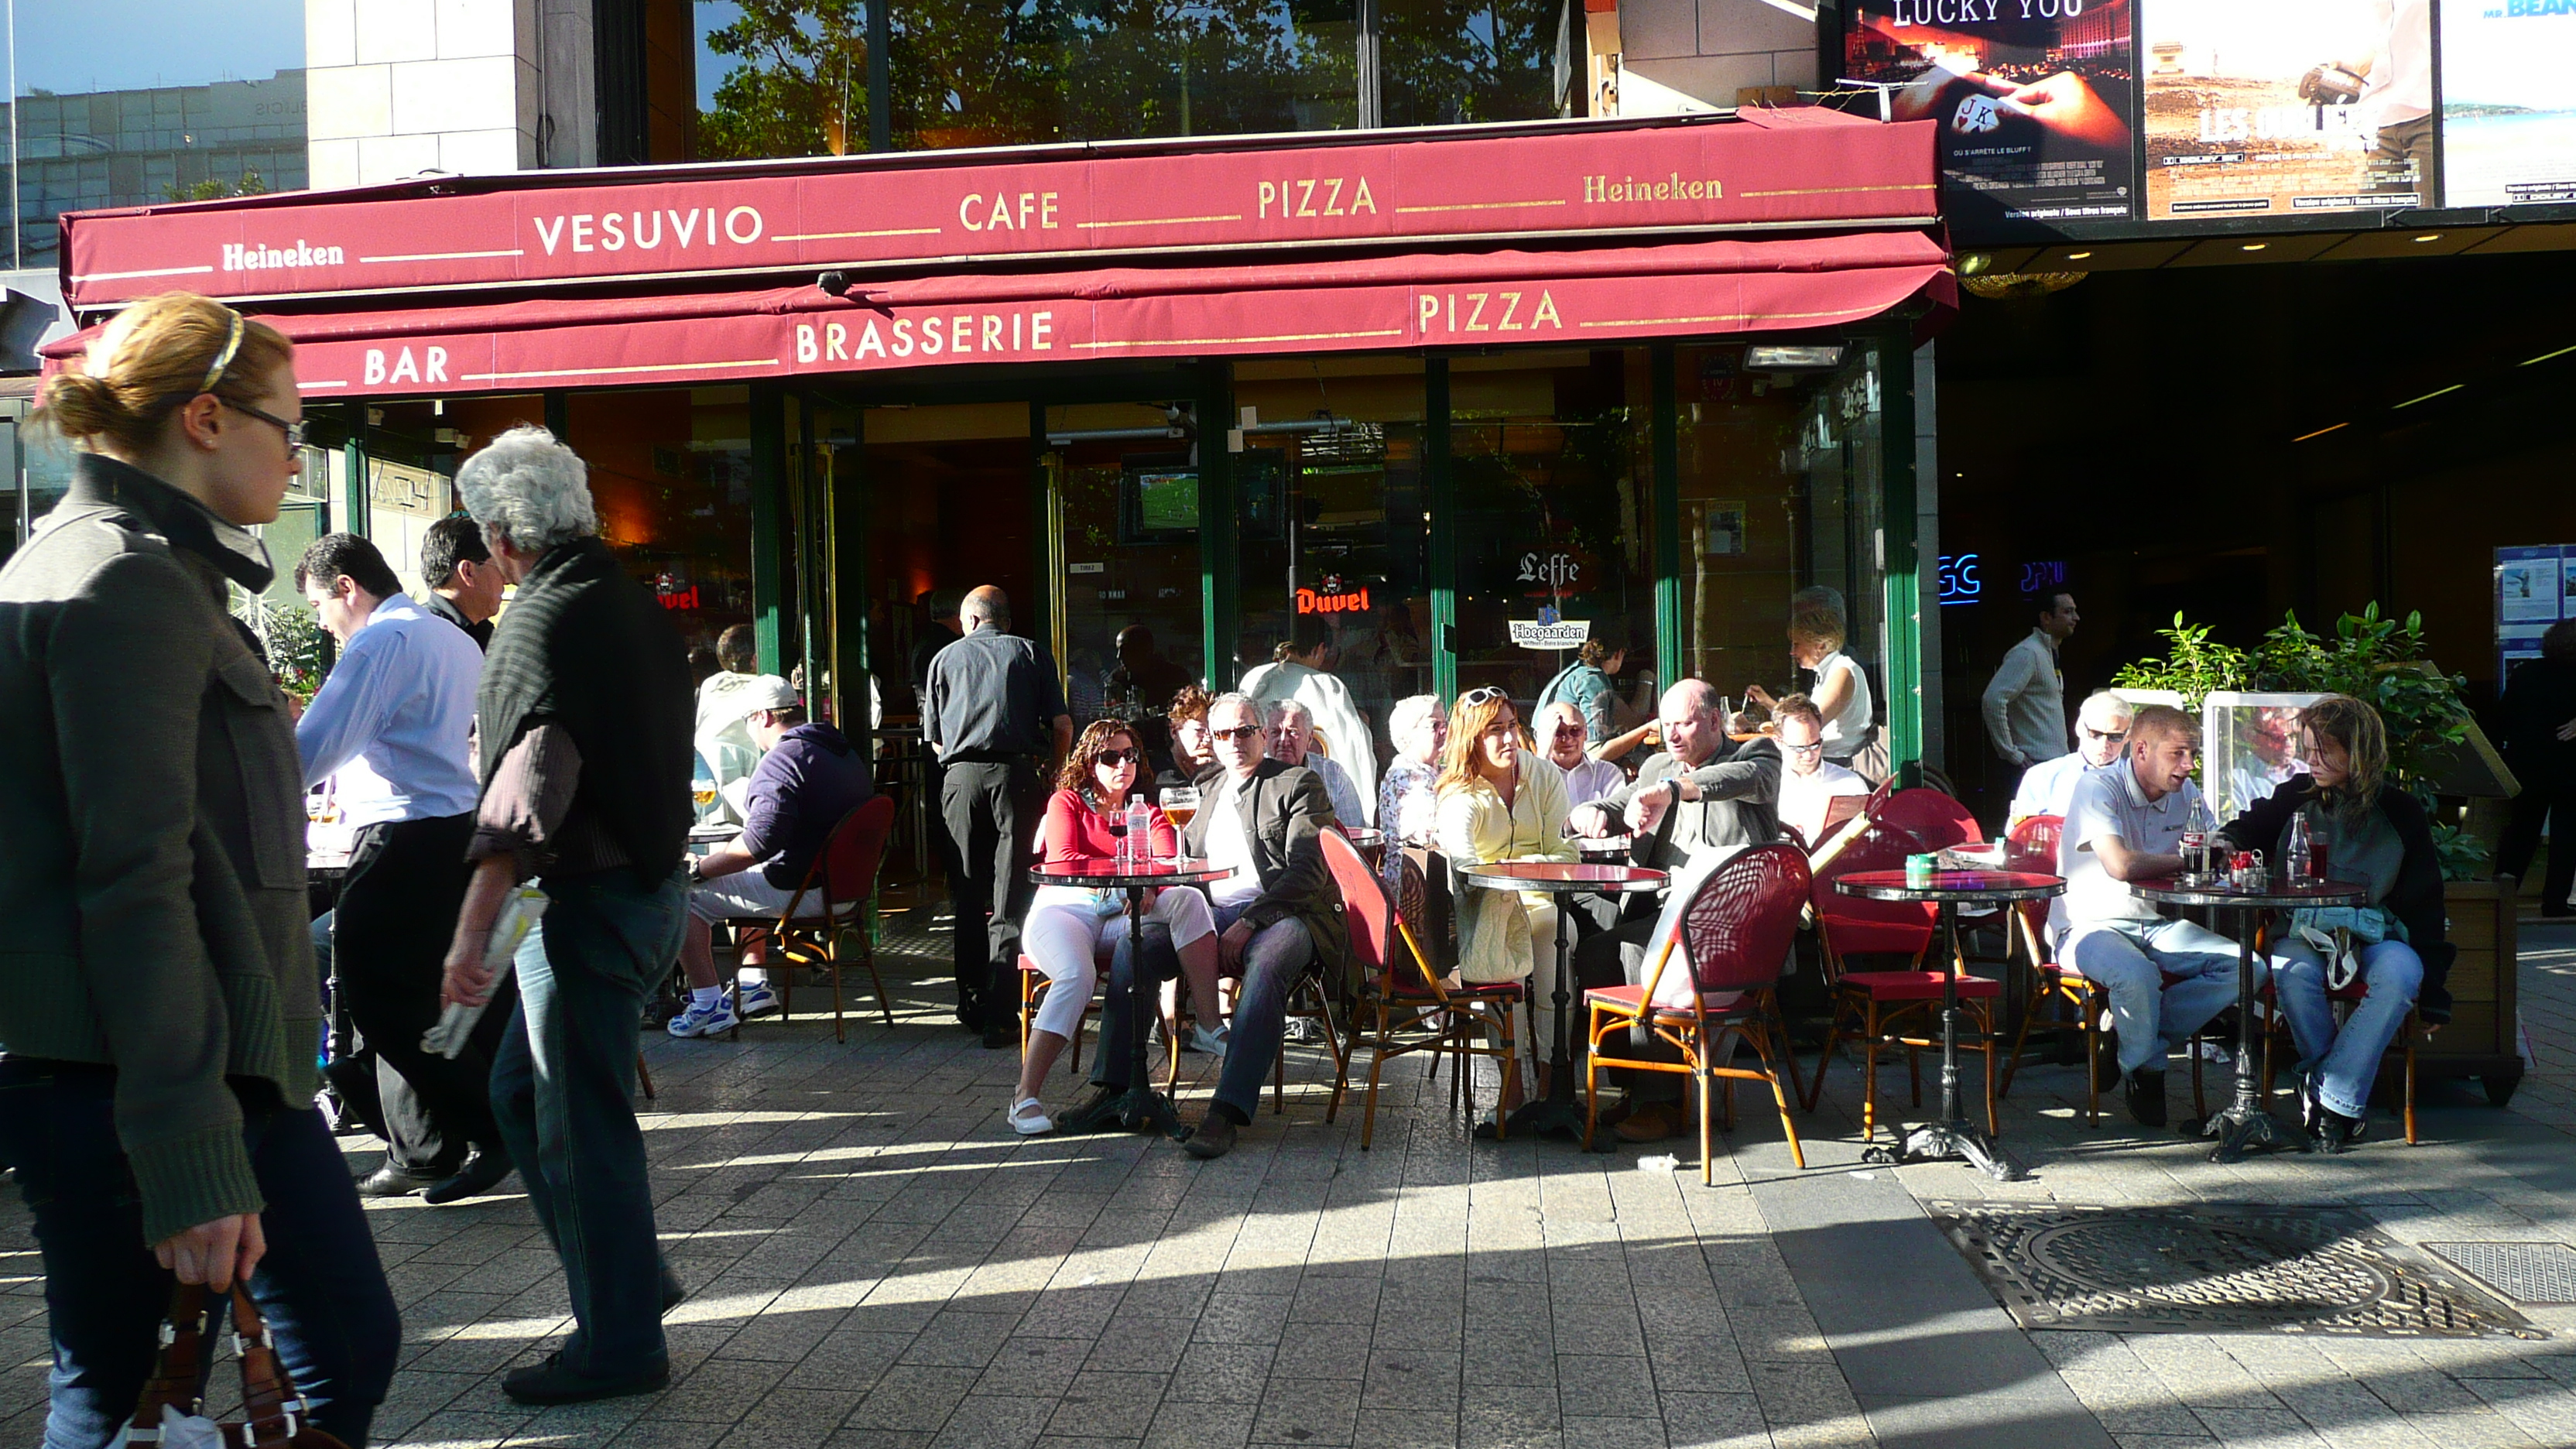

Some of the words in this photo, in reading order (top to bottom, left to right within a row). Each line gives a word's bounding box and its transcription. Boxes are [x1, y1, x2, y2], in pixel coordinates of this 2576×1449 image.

[1893, 0, 1998, 27] LUCKY
[2021, 0, 2082, 19] YOU
[1961, 99, 1976, 115] J
[1975, 106, 1992, 124] K
[2200, 107, 2249, 142] LES
[1258, 176, 1377, 219] PIZZA
[1583, 173, 1723, 204] Heineken
[959, 191, 1059, 232] CAFE
[2005, 210, 2030, 218] Version
[533, 205, 764, 256] VESUVIO
[222, 239, 344, 271] Heineken
[1418, 289, 1562, 333] PIZZA
[796, 311, 1053, 364] BRASSERIE
[364, 345, 448, 385] BAR
[1516, 552, 1580, 586] Leffe
[656, 585, 701, 610] vel
[1295, 586, 1369, 615] Duvel
[1512, 624, 1584, 641] Hoegaarden
